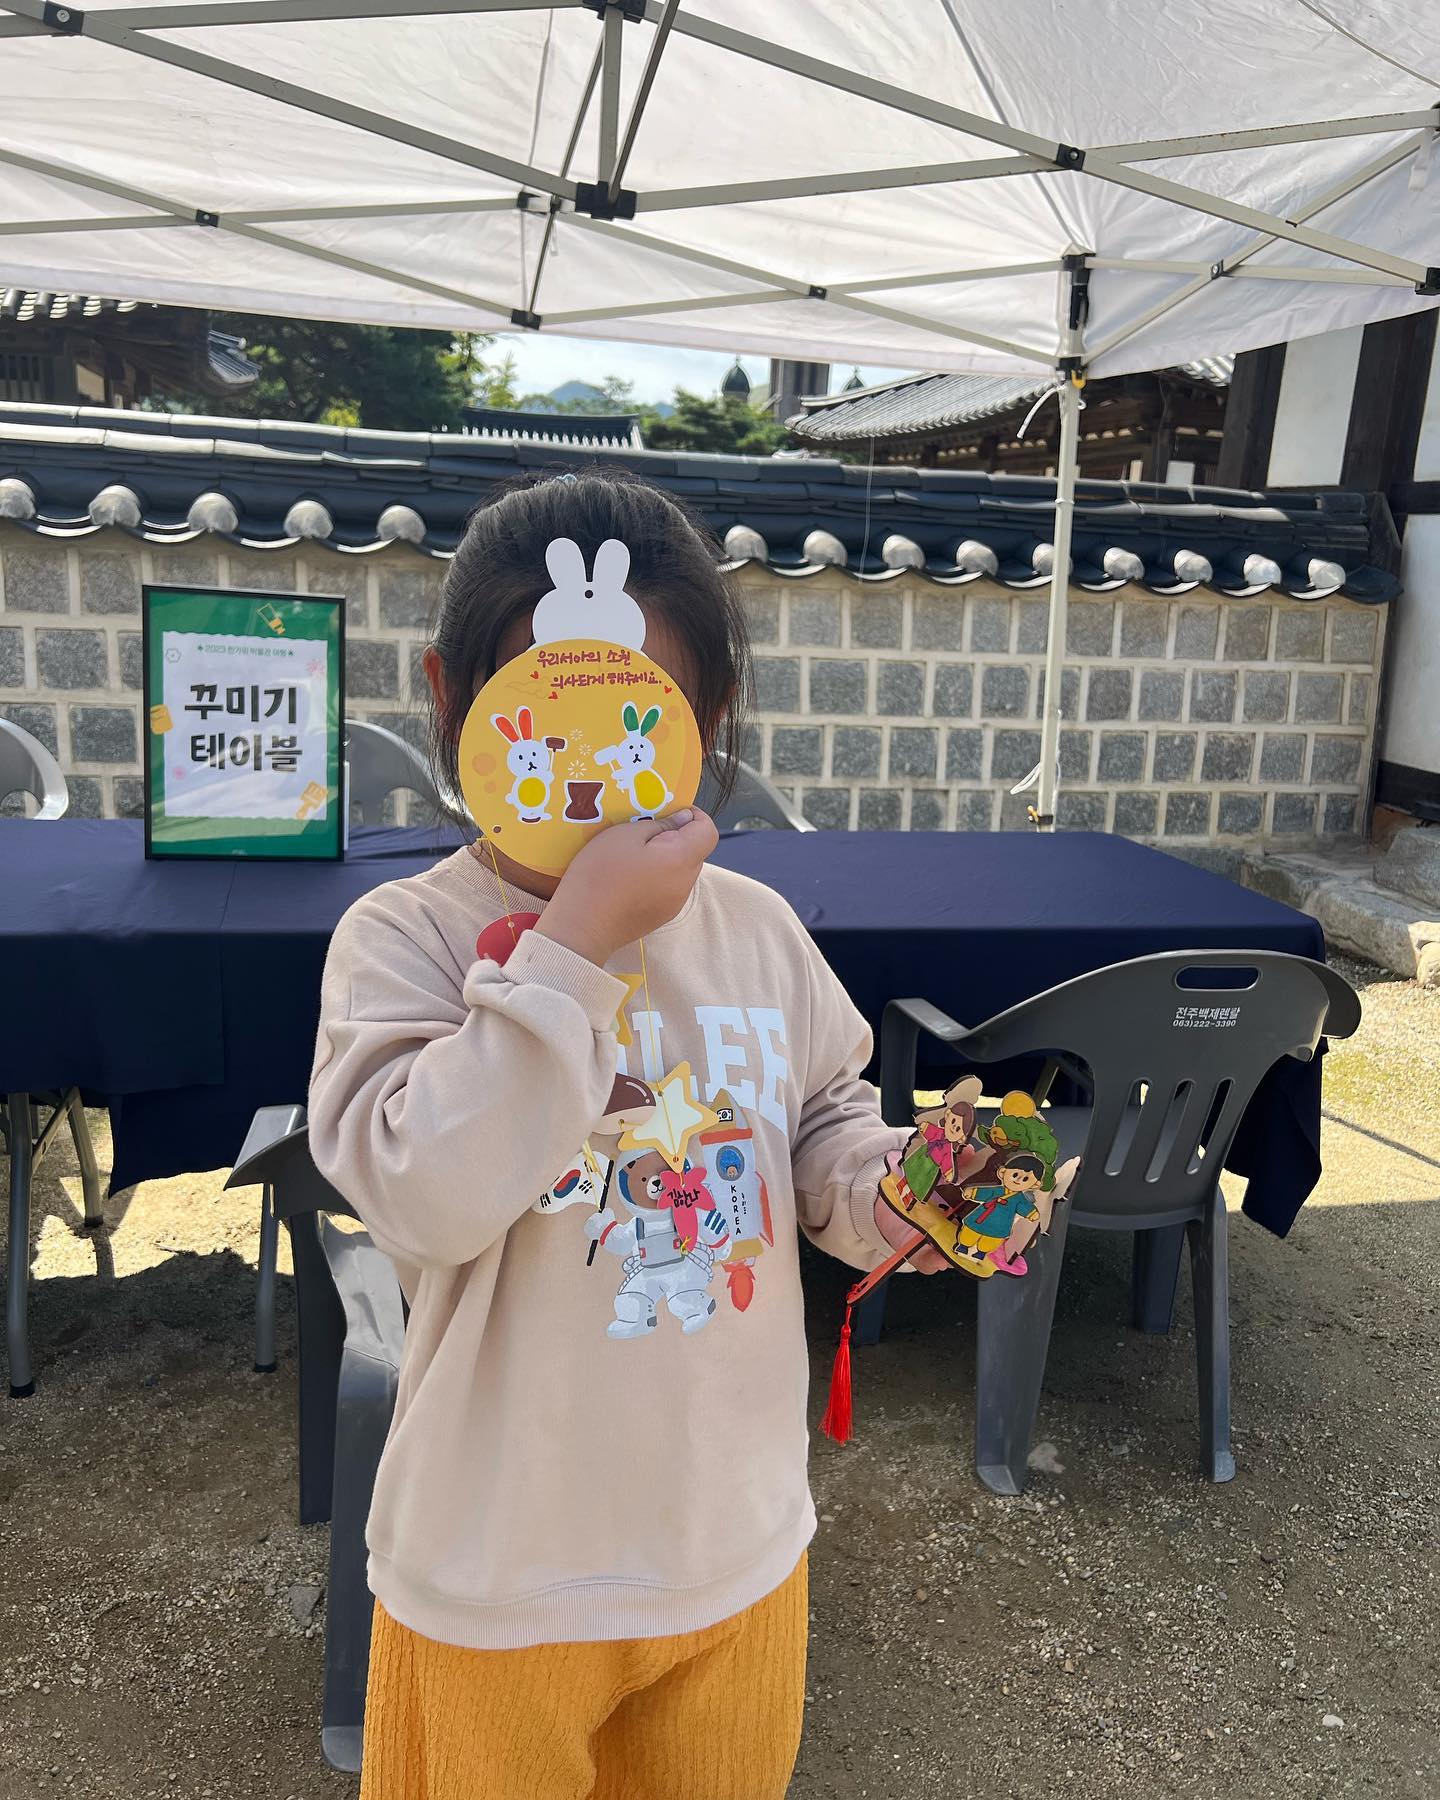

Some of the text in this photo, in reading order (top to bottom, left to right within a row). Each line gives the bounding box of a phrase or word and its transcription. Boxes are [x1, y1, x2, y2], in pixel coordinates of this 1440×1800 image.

[606, 649, 631, 666] 소원
[184, 683, 297, 724] 꾸미기
[190, 732, 303, 772] 테이블
[1172, 1019, 1237, 1028] 063)222-3390
[730, 1184, 742, 1236] KOREA
